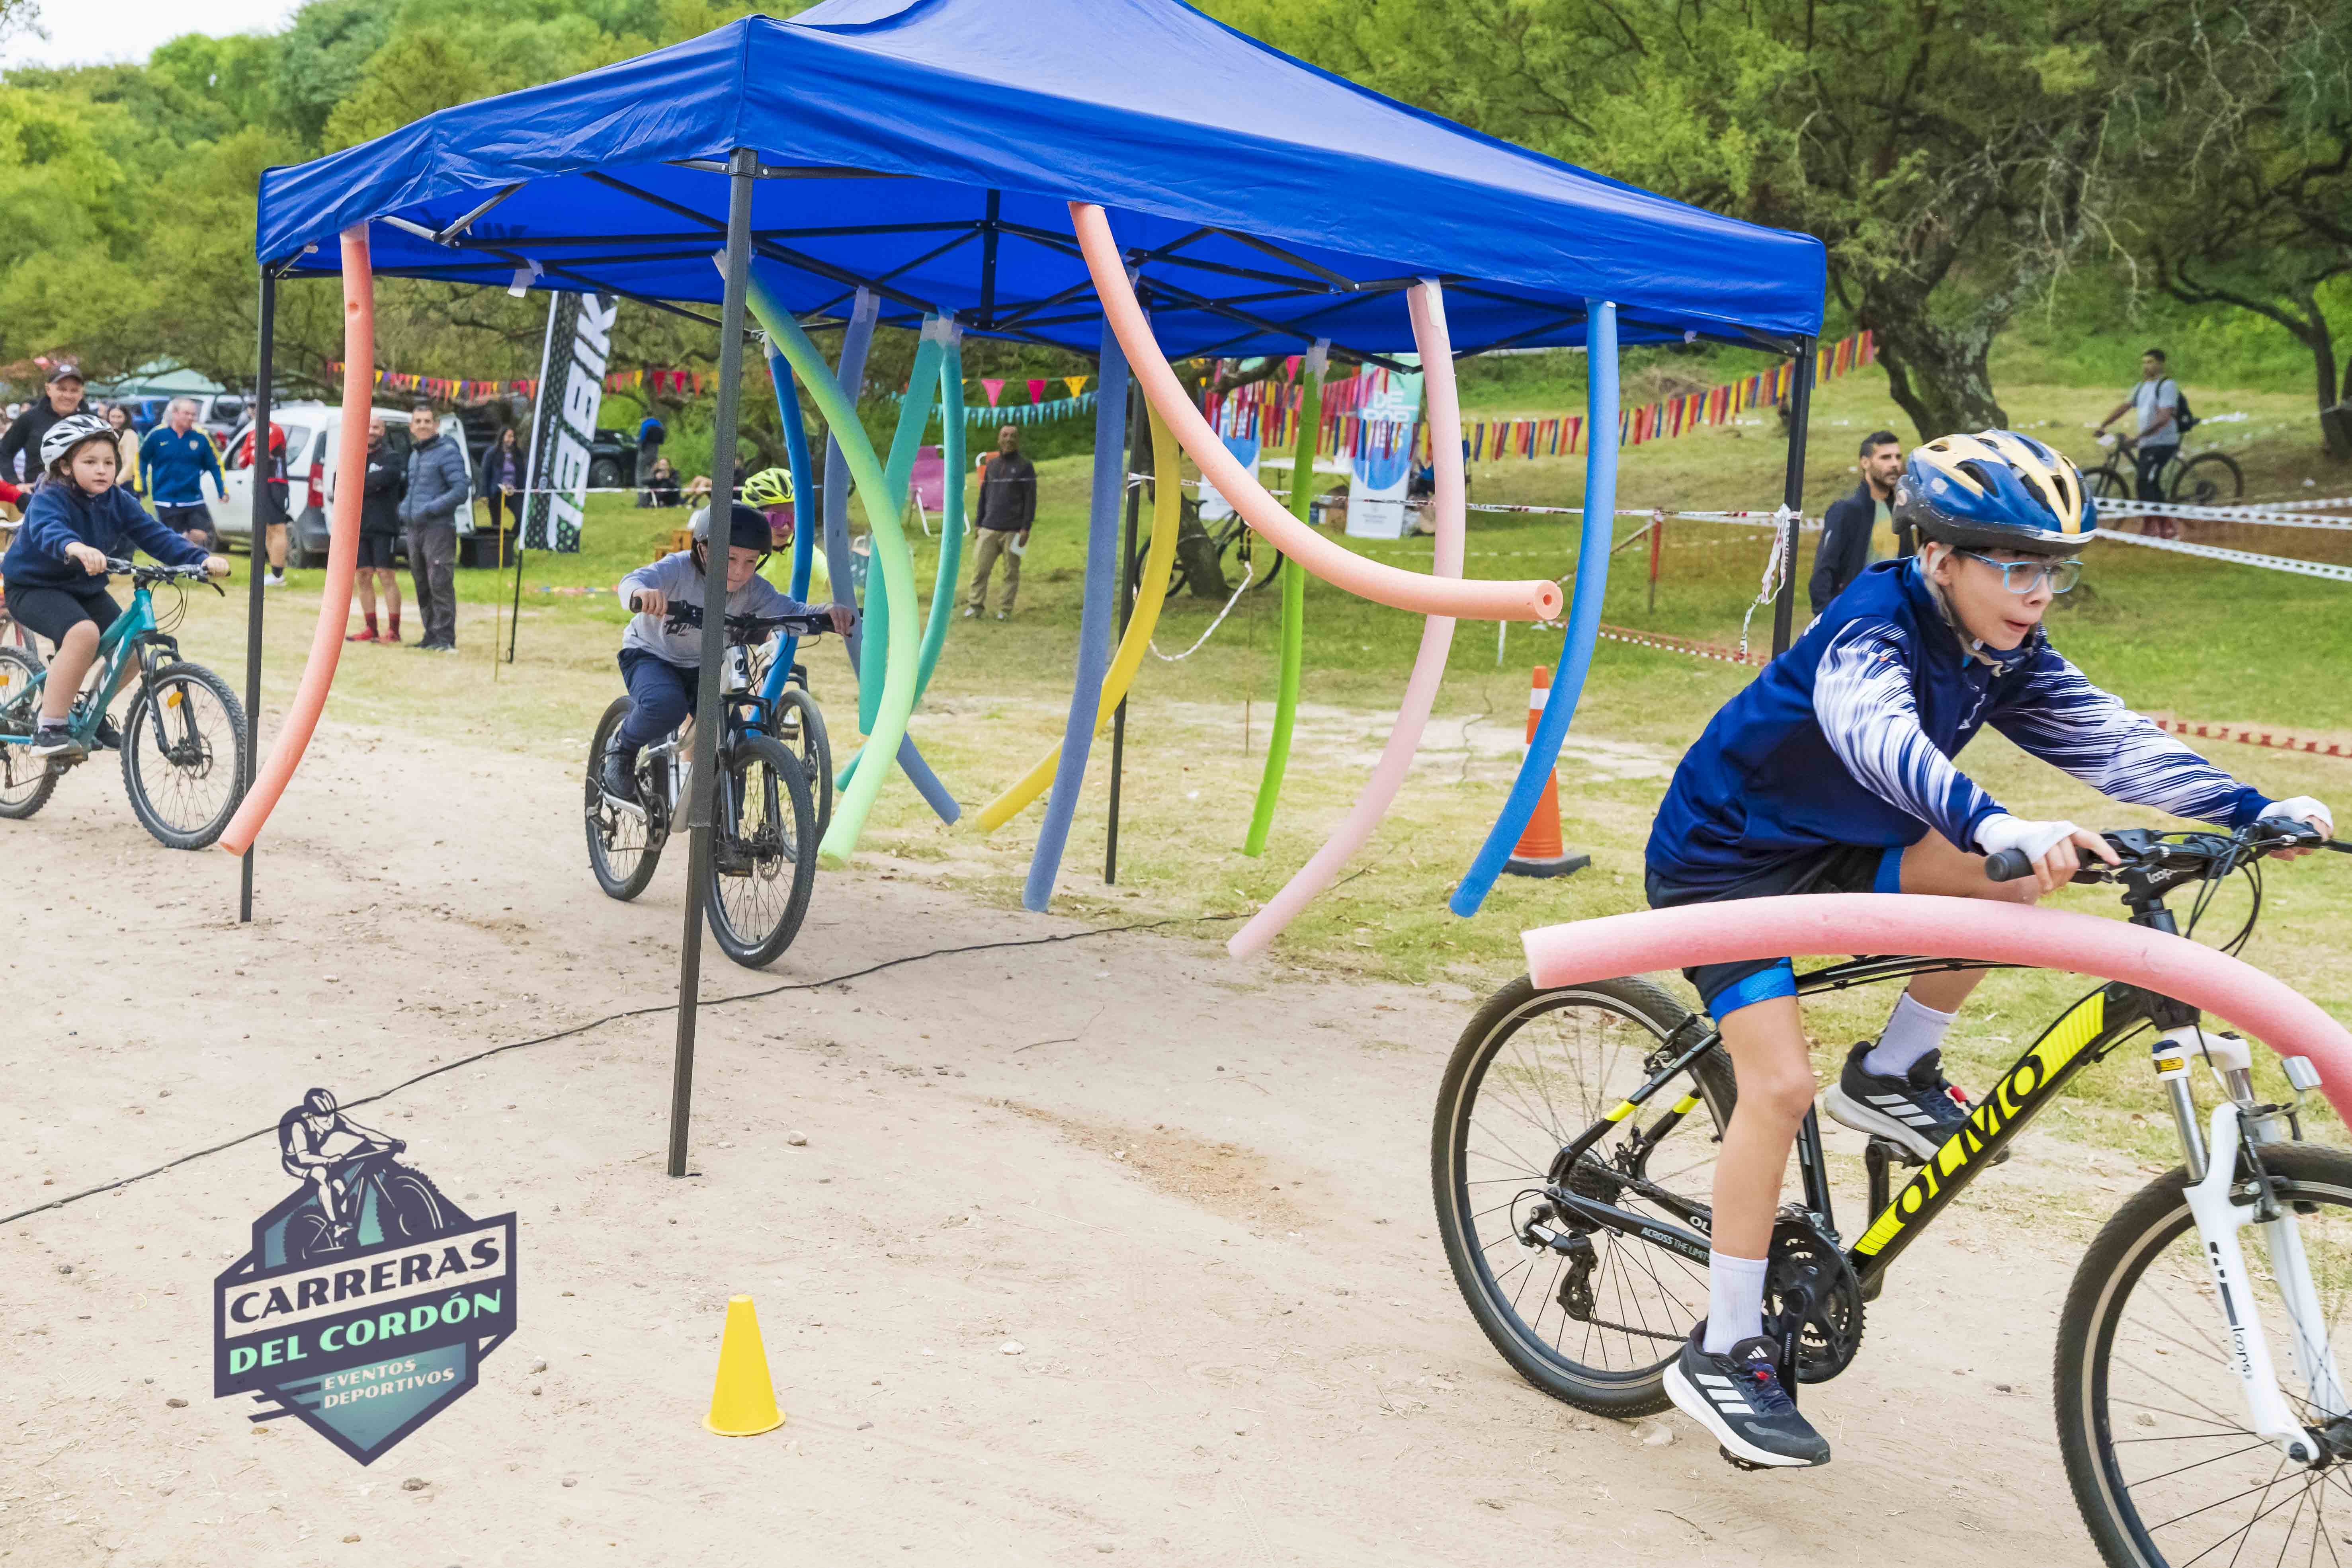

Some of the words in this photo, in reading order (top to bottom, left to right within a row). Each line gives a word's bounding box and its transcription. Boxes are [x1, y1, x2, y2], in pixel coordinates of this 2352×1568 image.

[1894, 1054, 2043, 1225] OLMO
[1689, 1216, 1711, 1234] OL
[1641, 1227, 1673, 1244] ACROSS
[1674, 1238, 1689, 1252] THE
